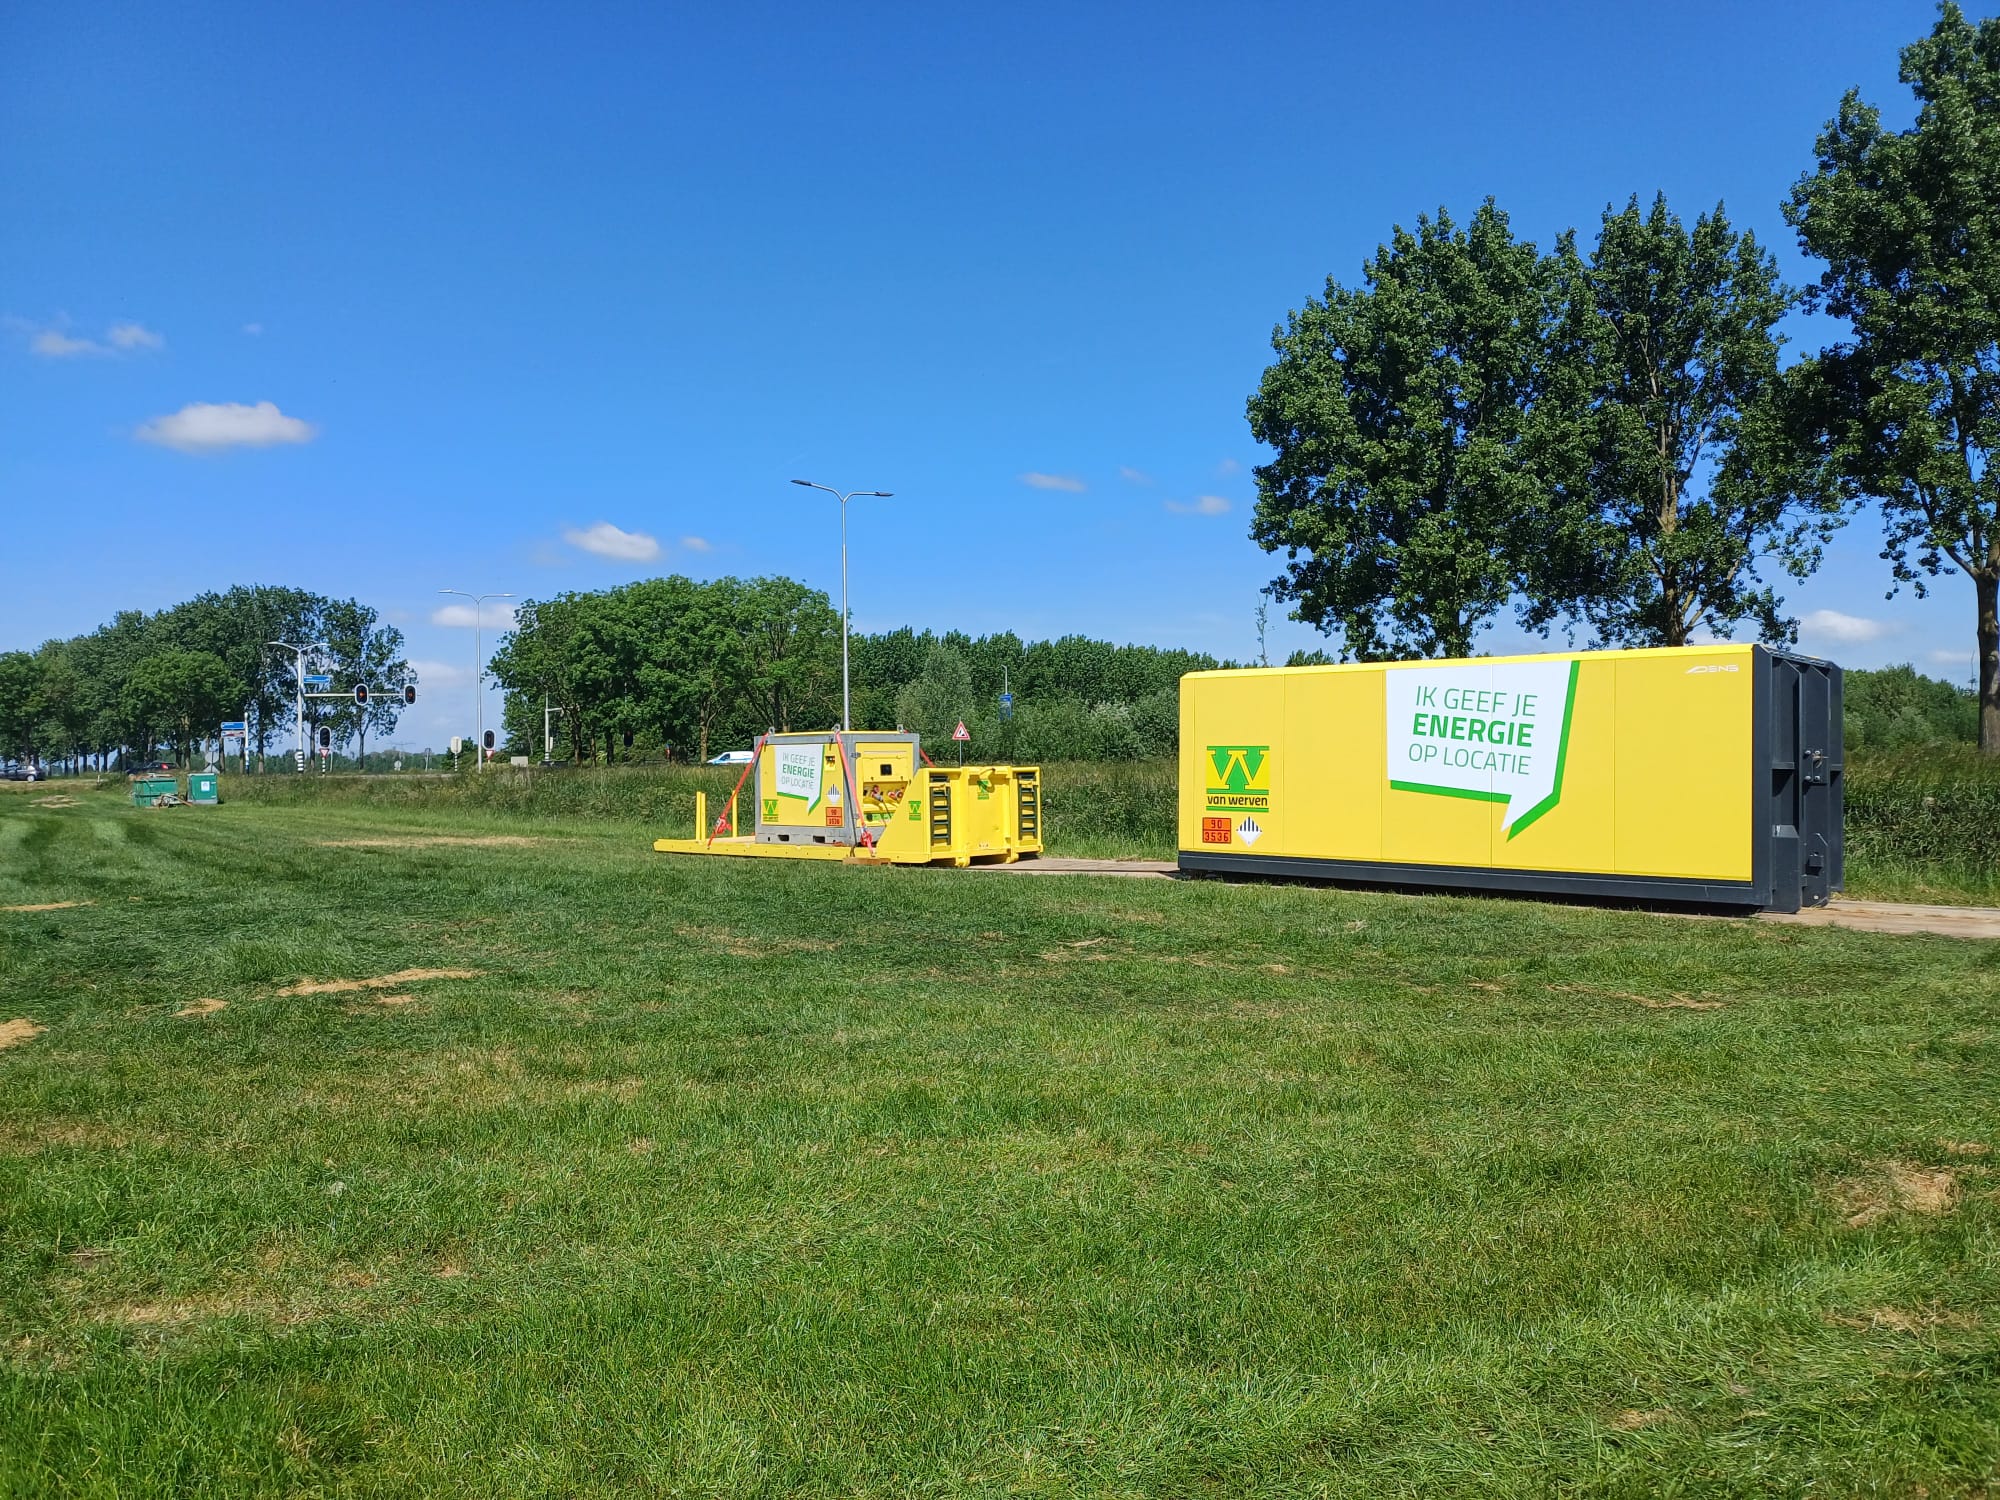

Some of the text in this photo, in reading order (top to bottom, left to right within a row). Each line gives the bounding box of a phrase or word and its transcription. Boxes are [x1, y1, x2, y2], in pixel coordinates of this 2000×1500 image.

[1416, 685, 1538, 717] IK GEEF JE
[1413, 713, 1534, 747] ENERGIE
[1408, 743, 1532, 775] OP LOCATIE
[782, 763, 815, 779] ENERGIE
[1207, 795, 1268, 807] van werven
[1211, 819, 1223, 829] 90
[1204, 832, 1229, 842] 3536
